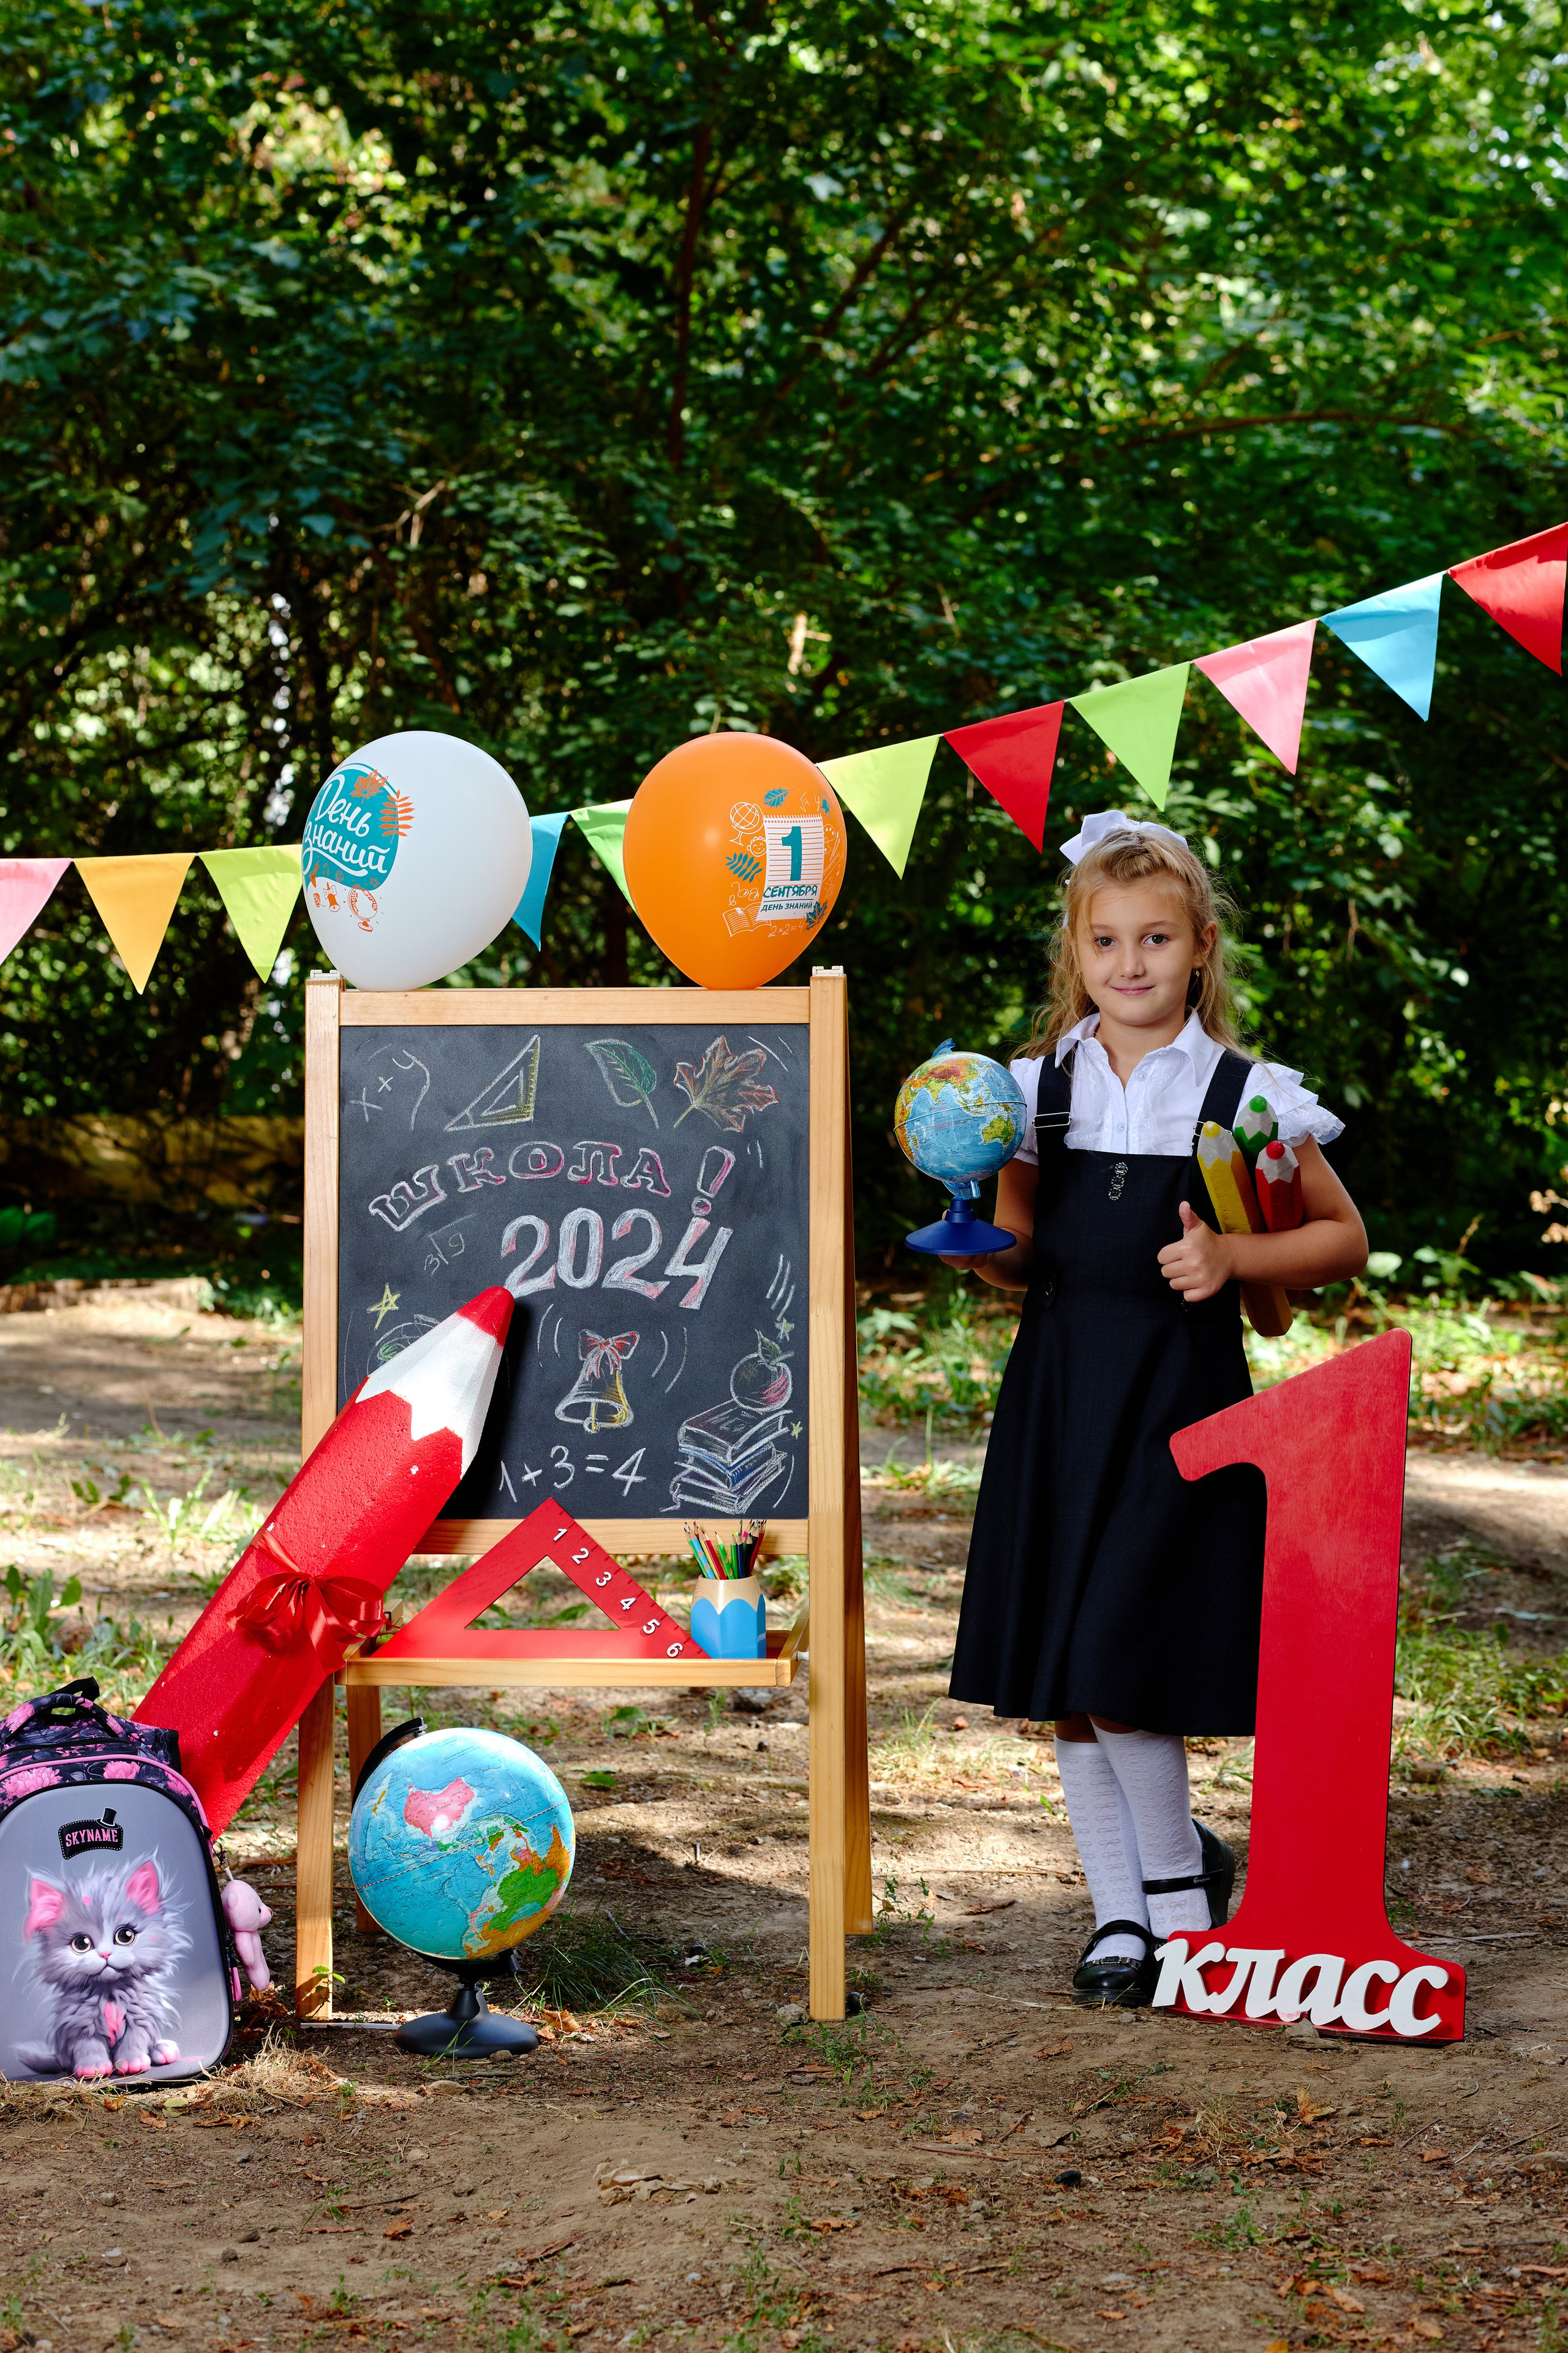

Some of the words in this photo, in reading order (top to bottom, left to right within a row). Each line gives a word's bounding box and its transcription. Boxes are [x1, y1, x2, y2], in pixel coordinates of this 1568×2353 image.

[315, 774, 372, 837] День
[781, 826, 802, 882] 1
[760, 903, 783, 913] ДЕНЬ
[785, 901, 813, 910] ЗНАНИЙ
[762, 884, 818, 898] СЕНТЯБРЯ
[500, 1207, 734, 1310] 2024
[553, 1528, 568, 1542] 1
[571, 1547, 589, 1565] 2
[596, 1571, 612, 1587] 3
[620, 1597, 636, 1611] 4
[643, 1618, 660, 1634] 5
[667, 1642, 684, 1658] 6
[1169, 1327, 1466, 2043] 1
[66, 1829, 118, 1847] SKYNAME
